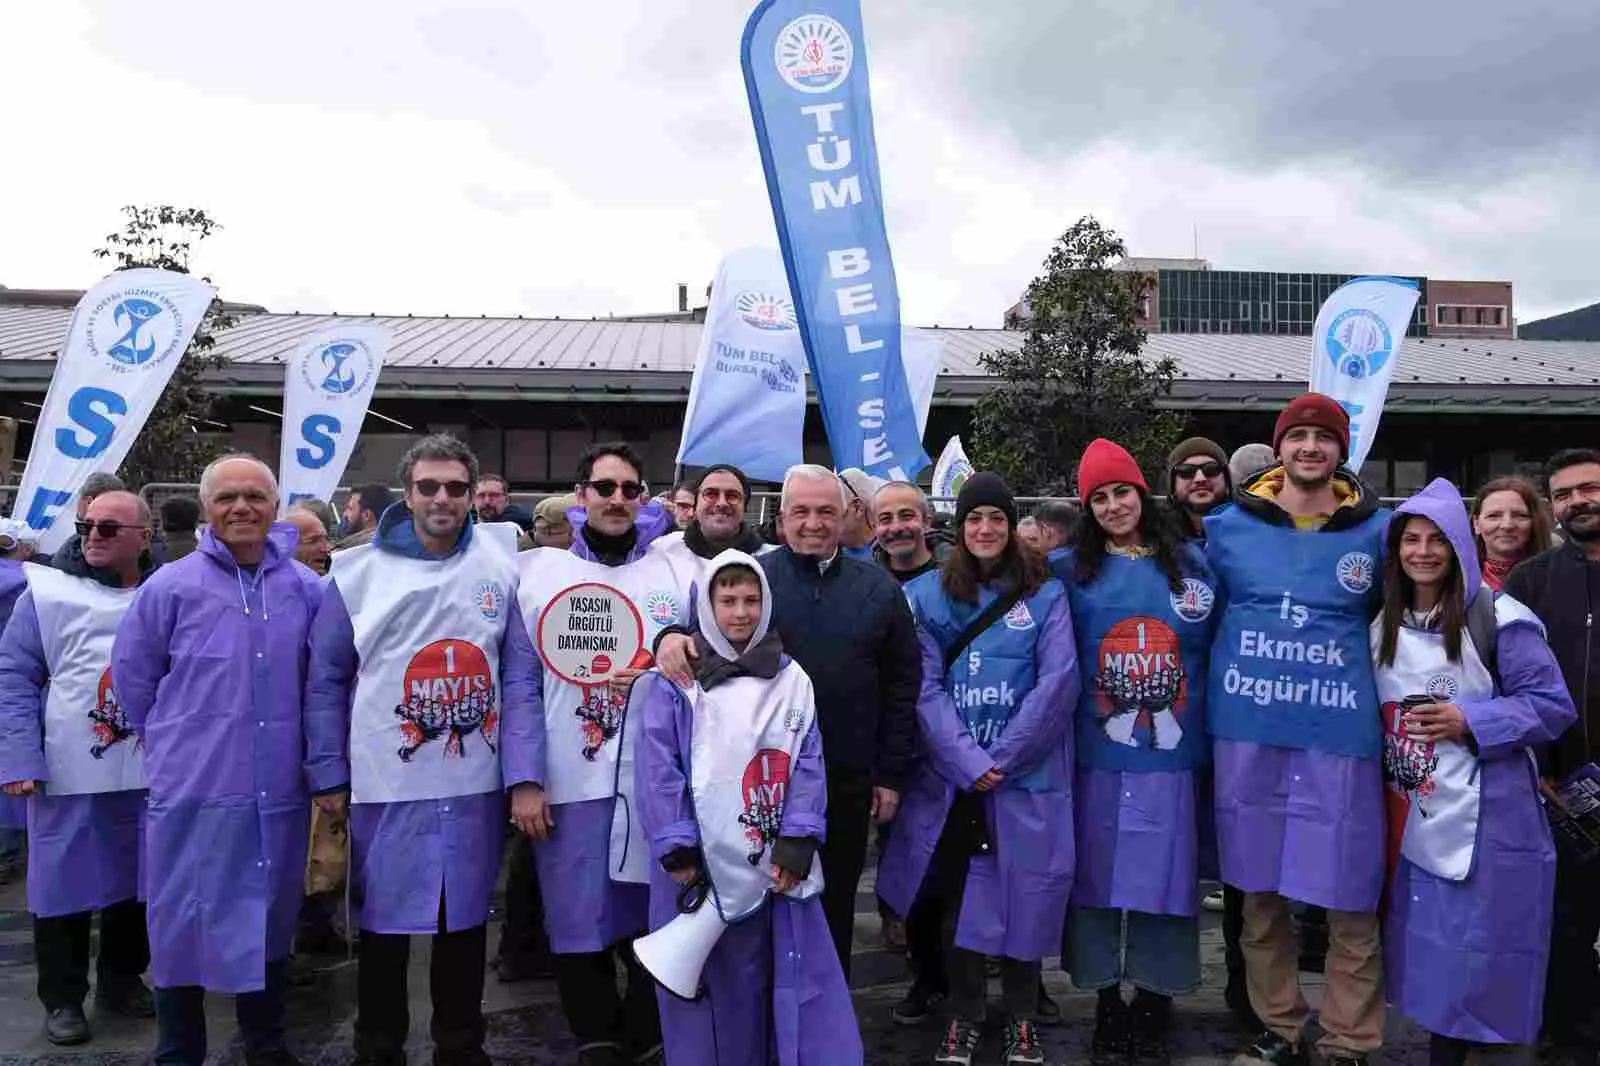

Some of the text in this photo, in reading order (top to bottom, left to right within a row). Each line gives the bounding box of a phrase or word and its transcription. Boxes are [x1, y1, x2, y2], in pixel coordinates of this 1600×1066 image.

[801, 103, 862, 210] TÜM
[569, 596, 611, 613] YAŞASIN
[568, 614, 612, 632] ÖRGÜTLÜ
[1137, 623, 1145, 649] 1
[445, 646, 454, 673] 1
[1240, 630, 1344, 667] Ekmek
[1104, 652, 1176, 676] MAYIS
[411, 674, 486, 701] MAYIS
[1224, 663, 1358, 709] Özgürlük
